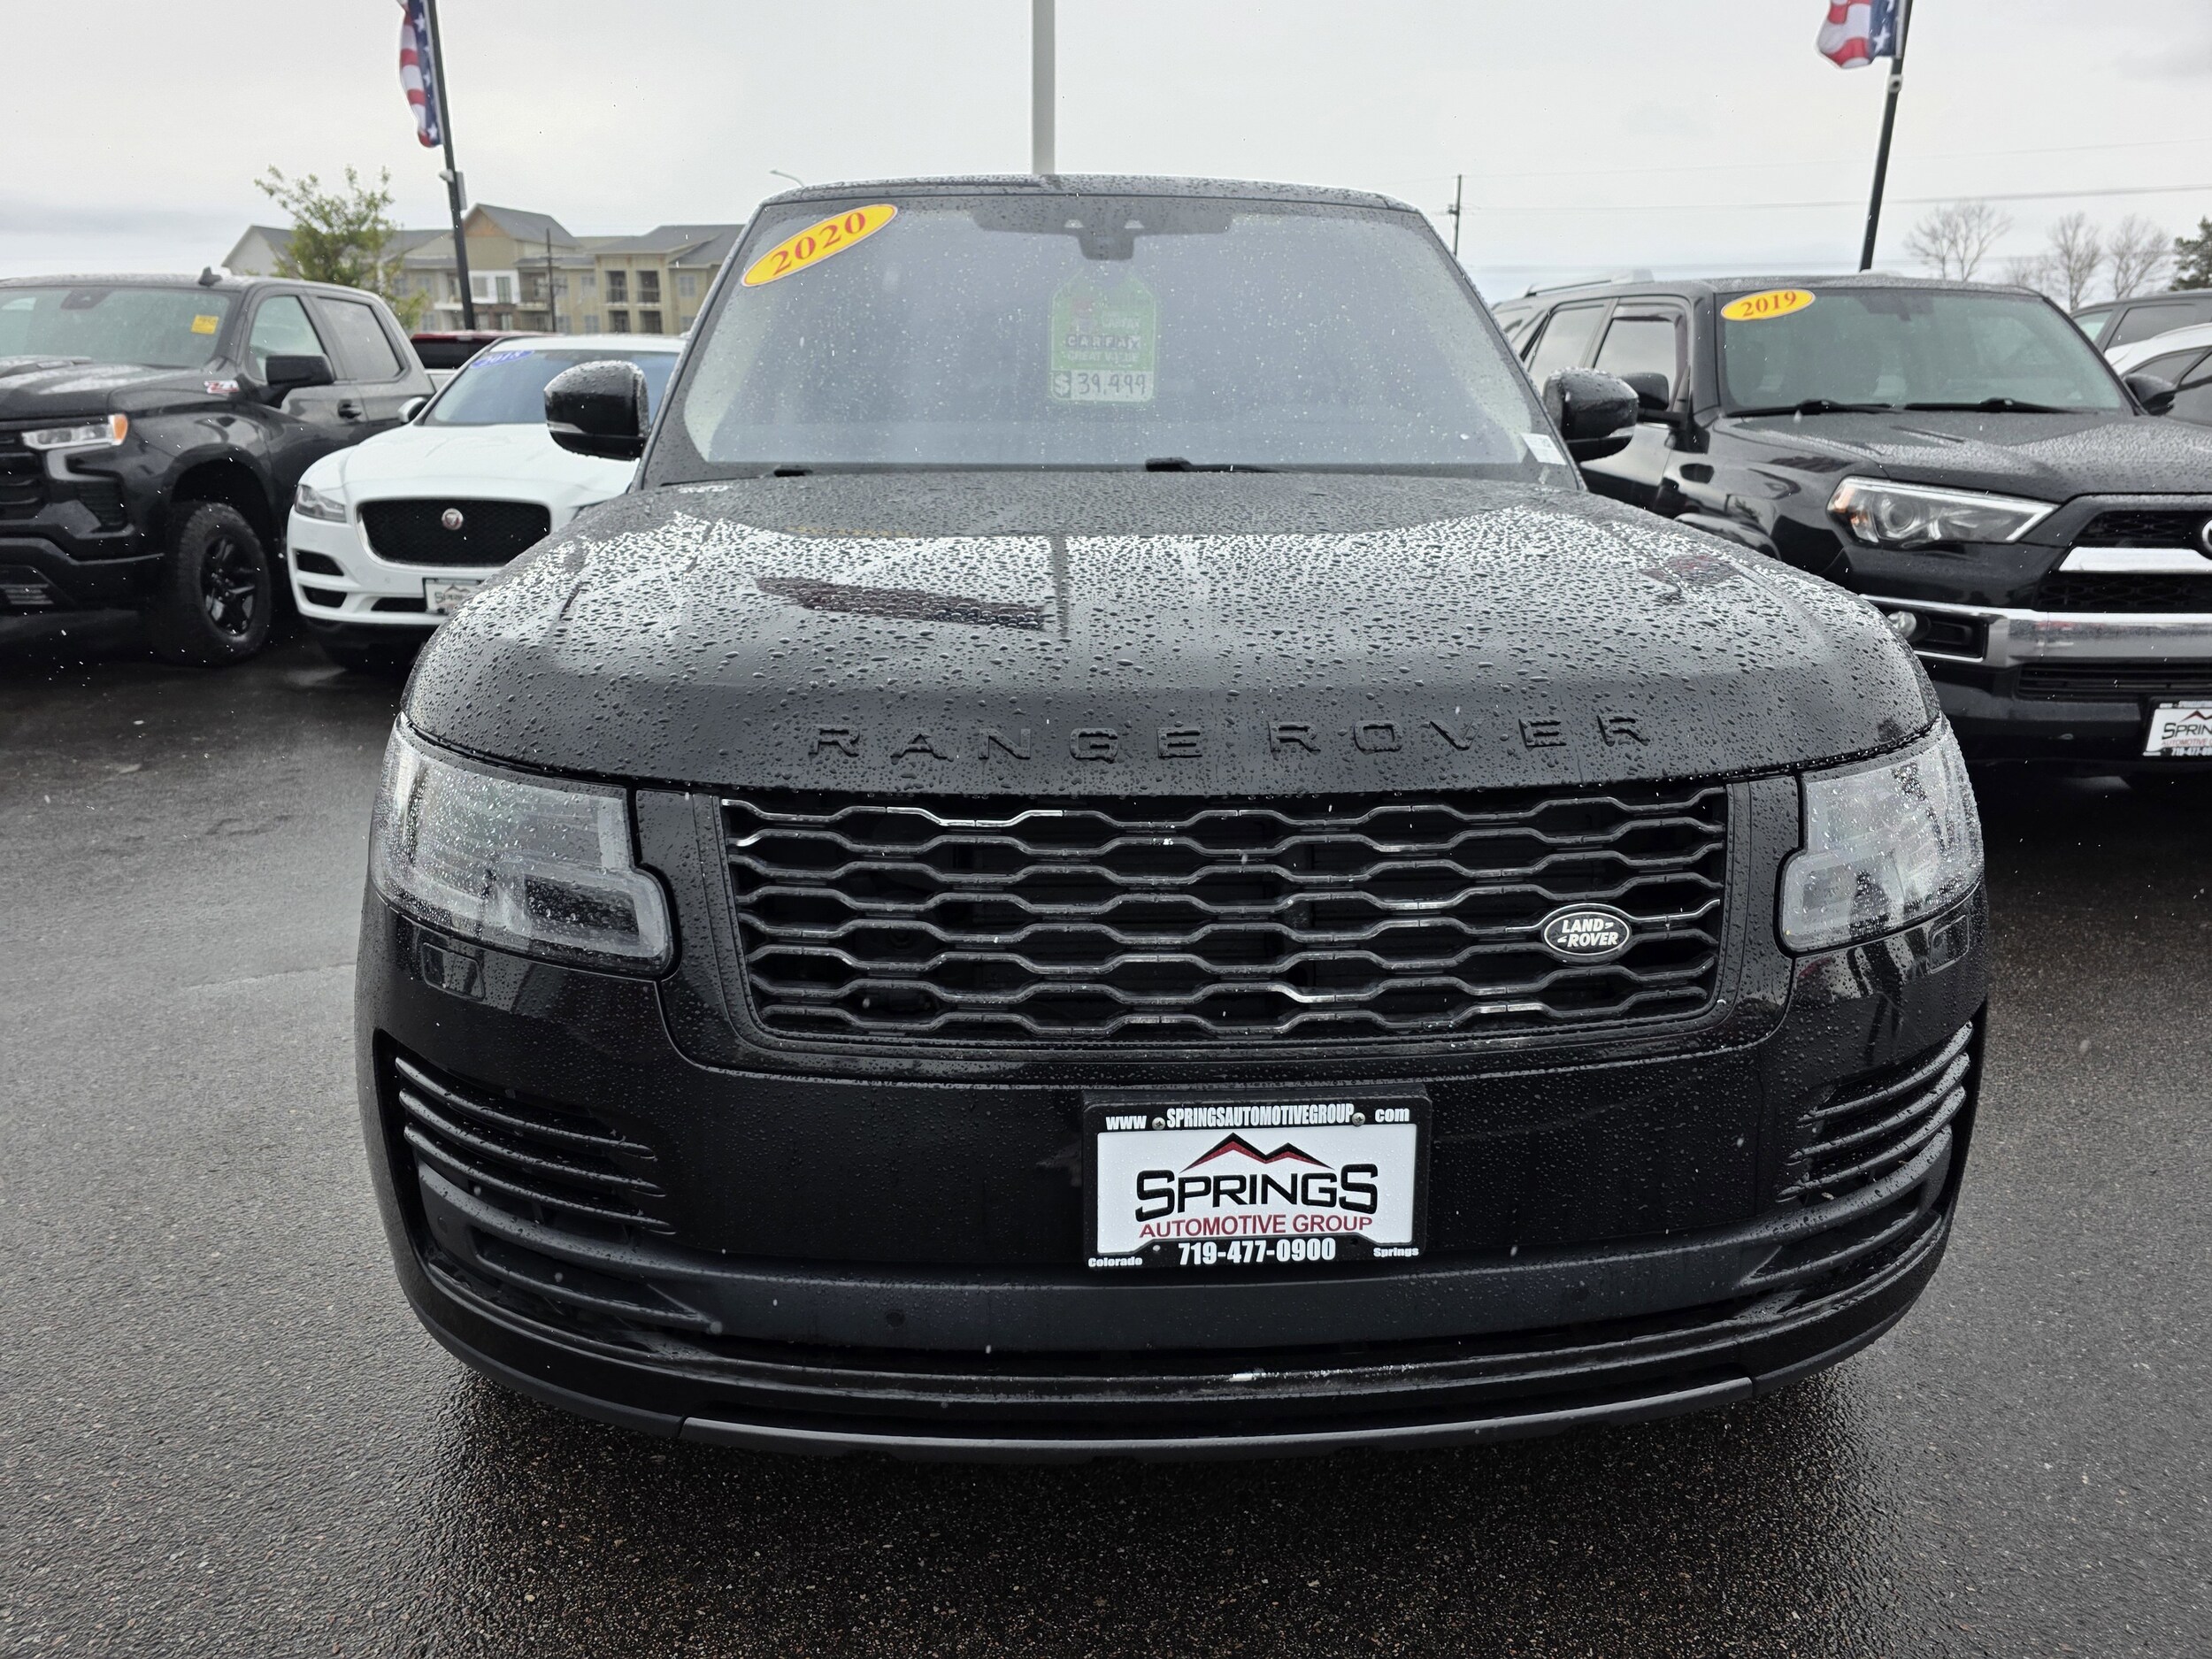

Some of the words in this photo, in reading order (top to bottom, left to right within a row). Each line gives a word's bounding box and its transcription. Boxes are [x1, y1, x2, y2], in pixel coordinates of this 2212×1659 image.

[770, 211, 866, 276] 2020
[1740, 291, 1797, 317] 2019
[1066, 334, 1141, 349] CARFAX
[808, 722, 1203, 762] RANGE
[1267, 713, 1651, 756] ROVER
[1562, 918, 1604, 933] LAND
[1567, 932, 1619, 948] ROVER
[1106, 1115, 1148, 1131] www
[1166, 1102, 1355, 1129] SPRINGSAUTOMOTIVEGROUP
[1374, 1107, 1410, 1123] com
[1135, 1164, 1379, 1222] SPRINGS
[1139, 1214, 1286, 1239] AUTOMOTIVE
[1292, 1214, 1373, 1233] GROUP
[1087, 1256, 1143, 1268] Colorado
[1372, 1246, 1419, 1259] Springs
[1178, 1238, 1336, 1265] 719-477-0900
